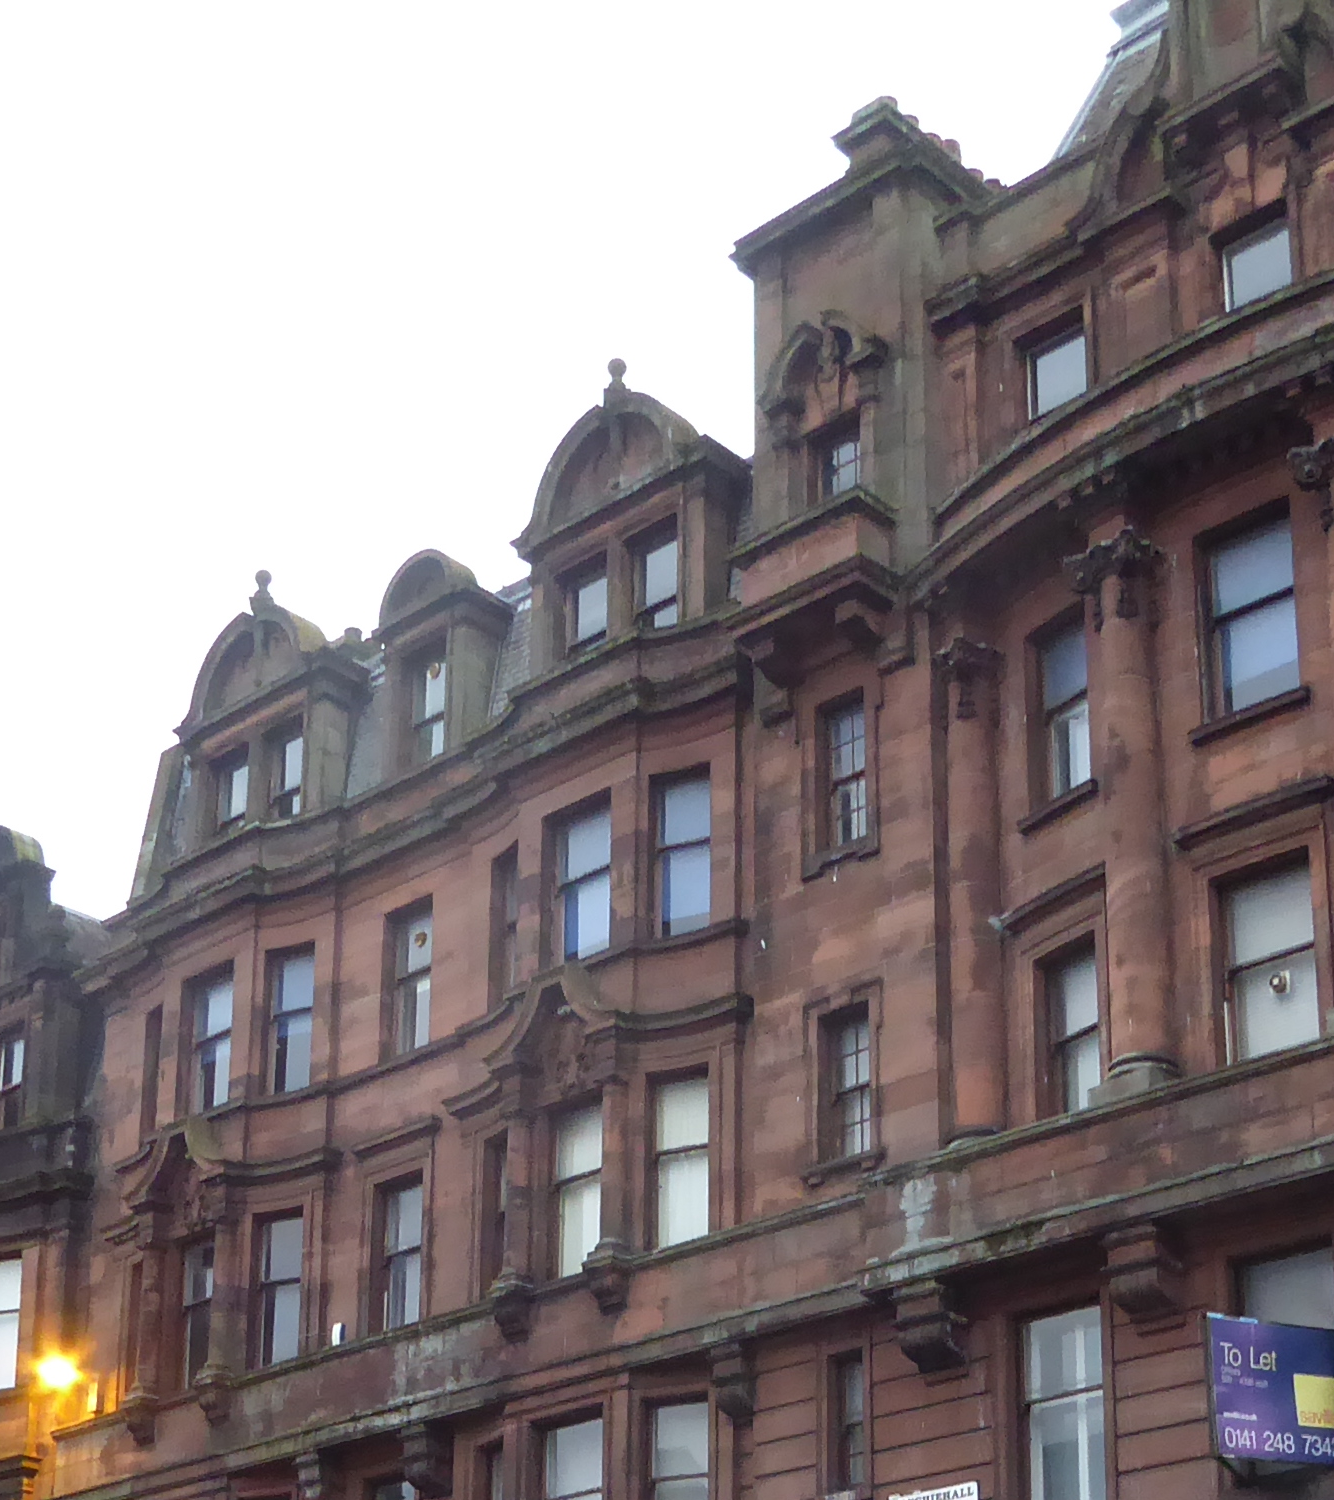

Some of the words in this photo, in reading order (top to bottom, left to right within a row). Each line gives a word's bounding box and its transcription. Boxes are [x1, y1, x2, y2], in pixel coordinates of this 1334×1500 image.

[1220, 1342, 1242, 1366] To
[1250, 1346, 1277, 1371] Let
[1225, 1428, 1256, 1449] 0141
[1263, 1431, 1295, 1453] 248
